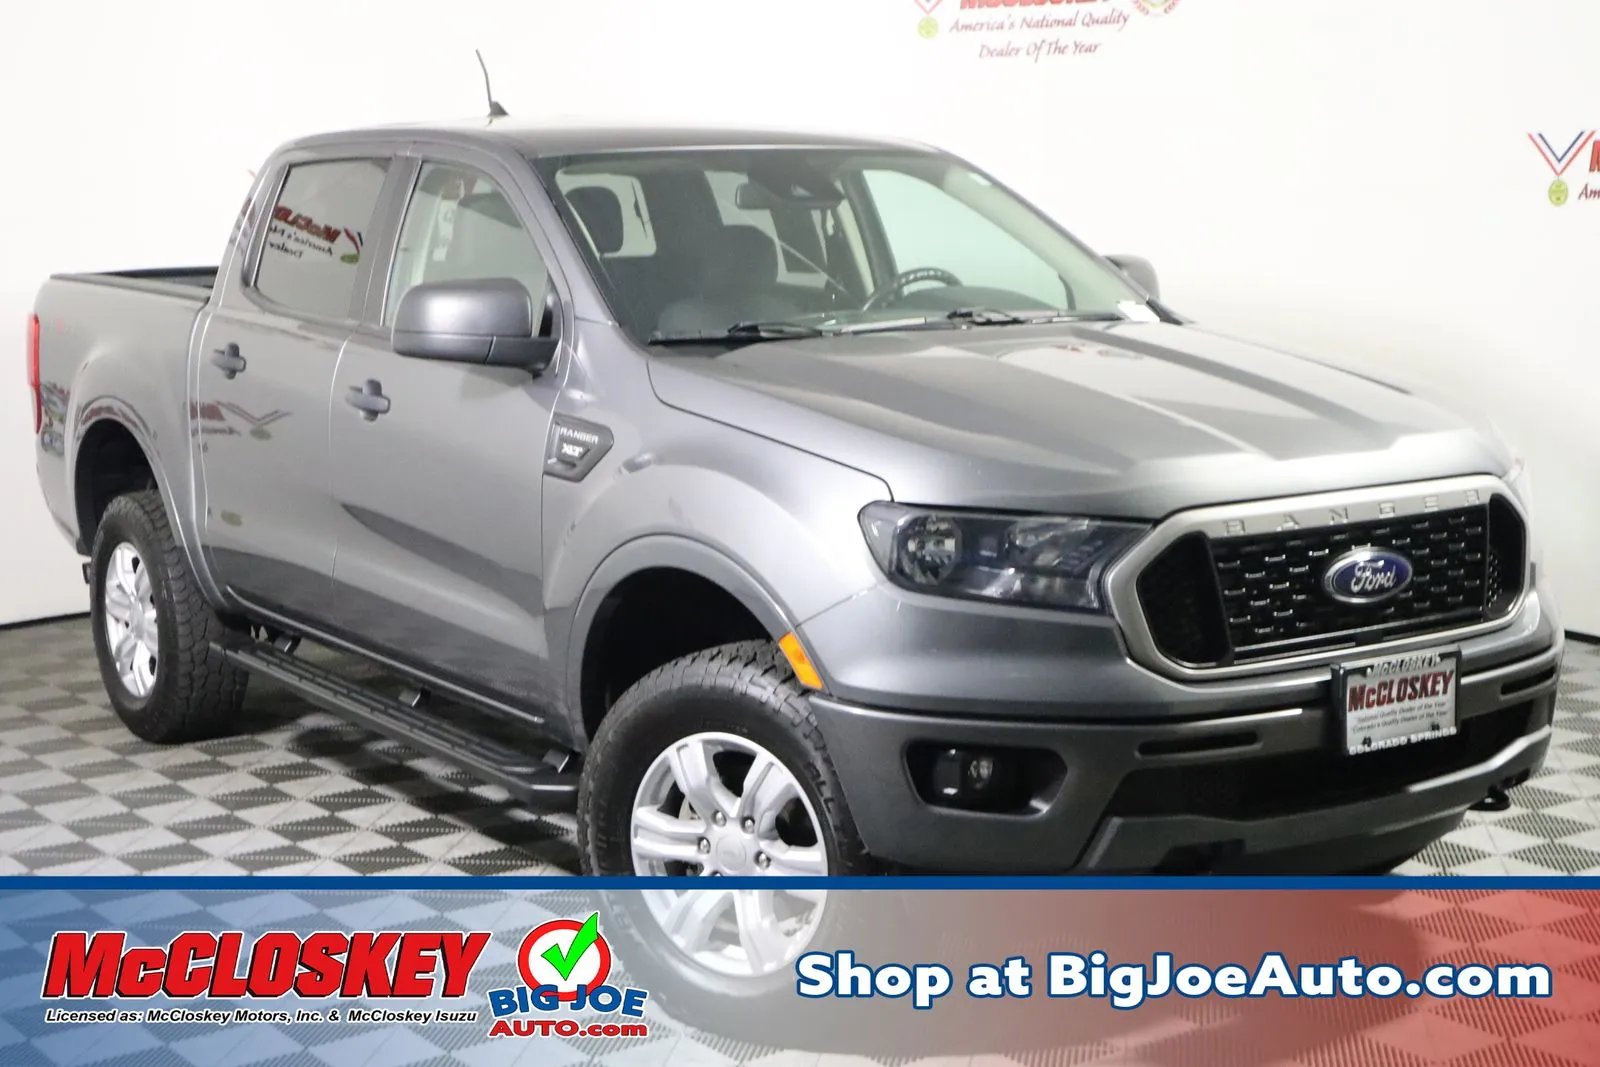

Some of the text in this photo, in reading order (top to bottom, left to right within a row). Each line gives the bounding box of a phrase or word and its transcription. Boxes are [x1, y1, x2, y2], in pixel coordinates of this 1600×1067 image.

[949, 8, 1130, 33] America's National Quality
[978, 39, 1102, 63] Dealer Of The Year
[560, 426, 599, 445] RANGER
[561, 442, 583, 457] XLT
[1223, 488, 1481, 537] RANGER
[1351, 560, 1398, 593] Ford
[1348, 670, 1454, 712] McCLOSKEY
